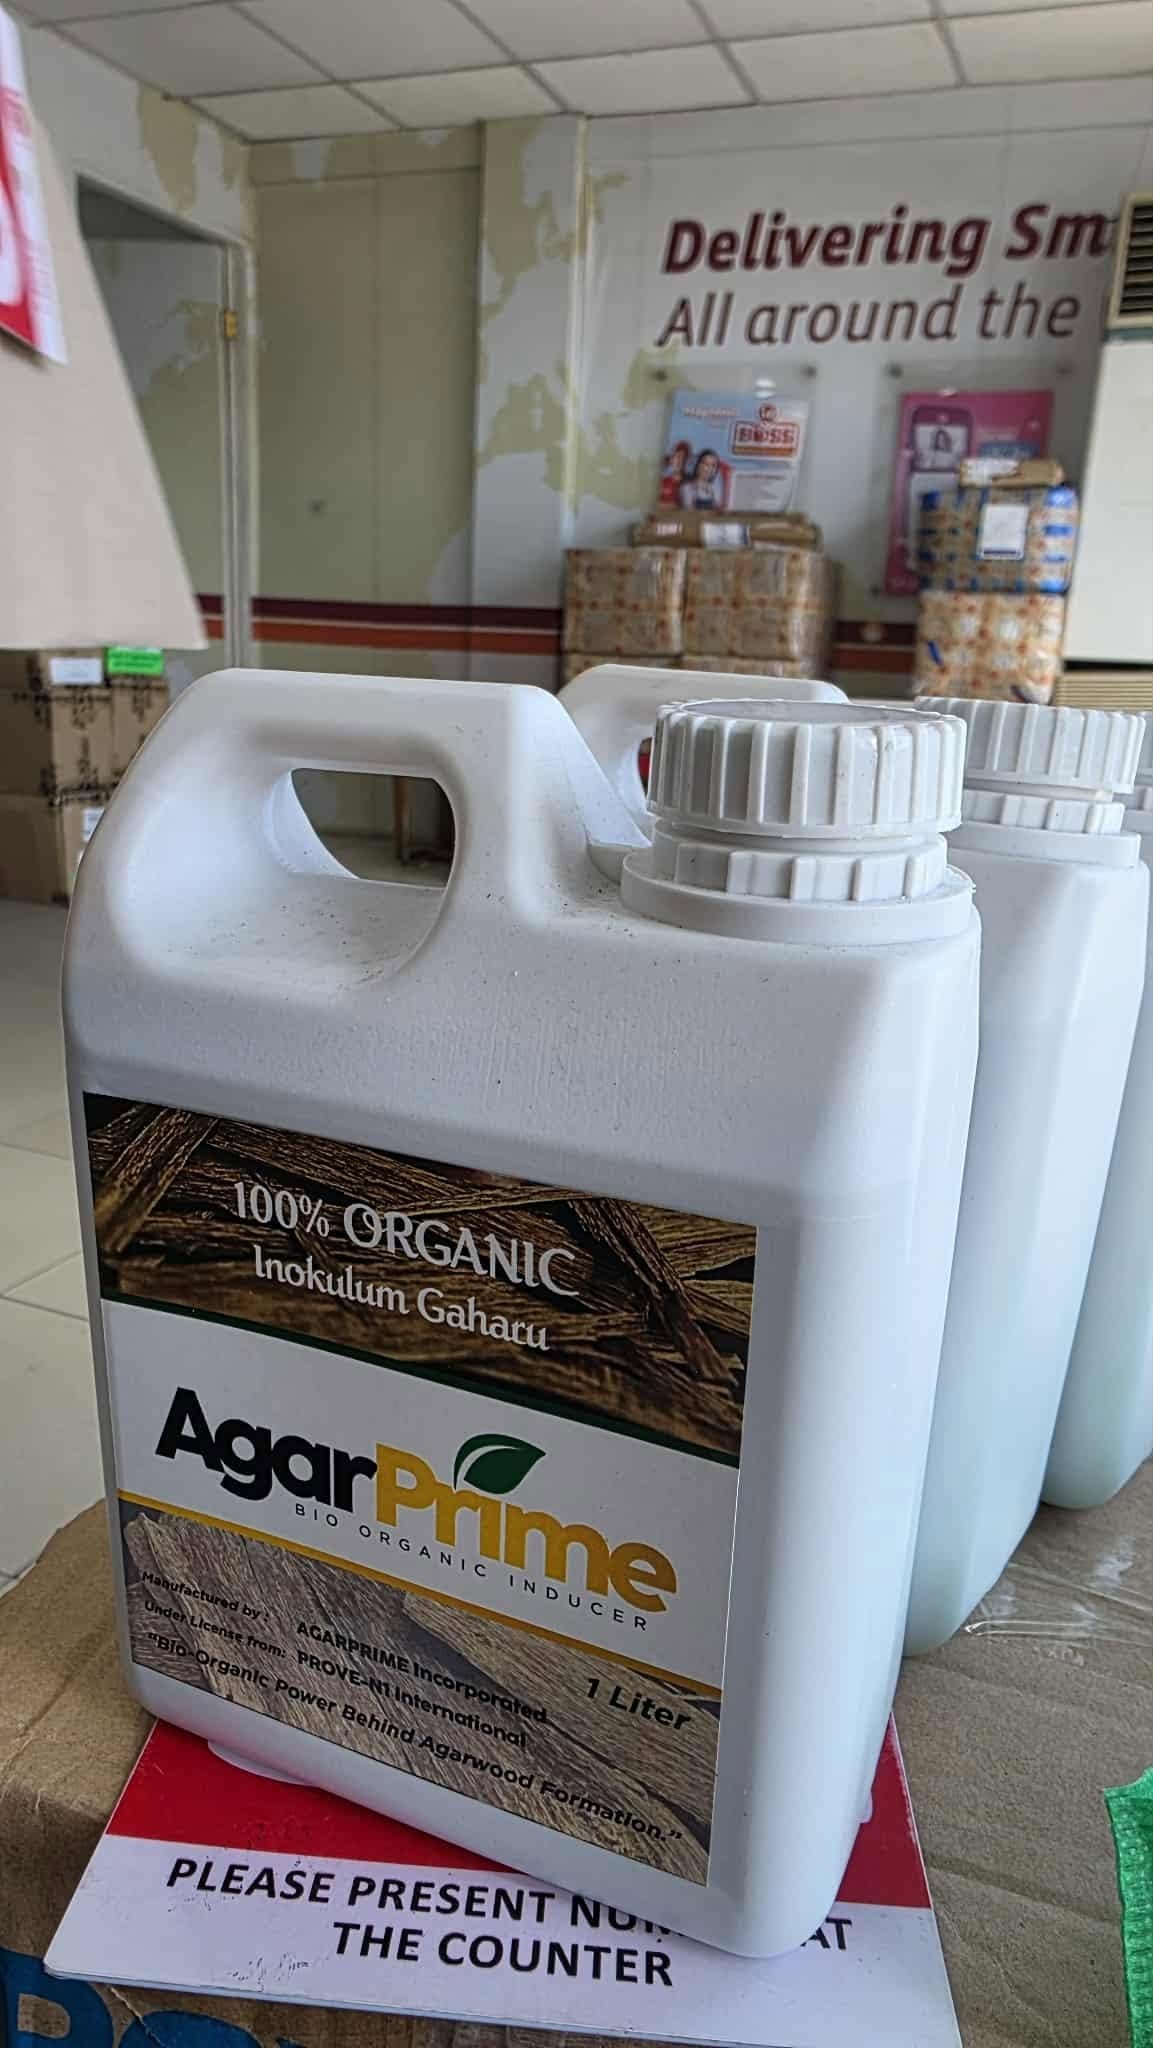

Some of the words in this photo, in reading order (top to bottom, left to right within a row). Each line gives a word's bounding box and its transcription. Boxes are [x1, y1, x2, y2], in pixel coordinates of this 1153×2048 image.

[662, 205, 990, 277] Delivering
[655, 292, 734, 347] All
[744, 284, 962, 344] around
[978, 282, 1081, 340] the
[234, 1182, 330, 1238] 100%
[343, 1203, 580, 1297] ORGANIC
[253, 1245, 410, 1315] Inokulum
[417, 1287, 551, 1351] Gaharu
[155, 1386, 679, 1614] AgarPrime
[295, 1503, 339, 1528] BIO
[359, 1524, 488, 1578] ORGANIC
[509, 1574, 649, 1633] INDUCER
[141, 1571, 238, 1613] Manufactured
[296, 1621, 411, 1674] AGARPRIME
[413, 1662, 548, 1724] Incorporated
[143, 1600, 188, 1624] Under
[190, 1614, 245, 1644] License
[247, 1634, 287, 1659] from:
[394, 1685, 528, 1749] International
[273, 1678, 338, 1714] Power
[341, 1703, 416, 1745] Behind
[417, 1735, 535, 1790] Agarwood
[586, 1677, 602, 1699] 1
[607, 1685, 692, 1731] Liter
[166, 1858, 336, 1903] PLEASE
[347, 1875, 556, 1924] PRESENT
[333, 1921, 424, 1963] THE
[437, 1931, 674, 1987] COUNTER
